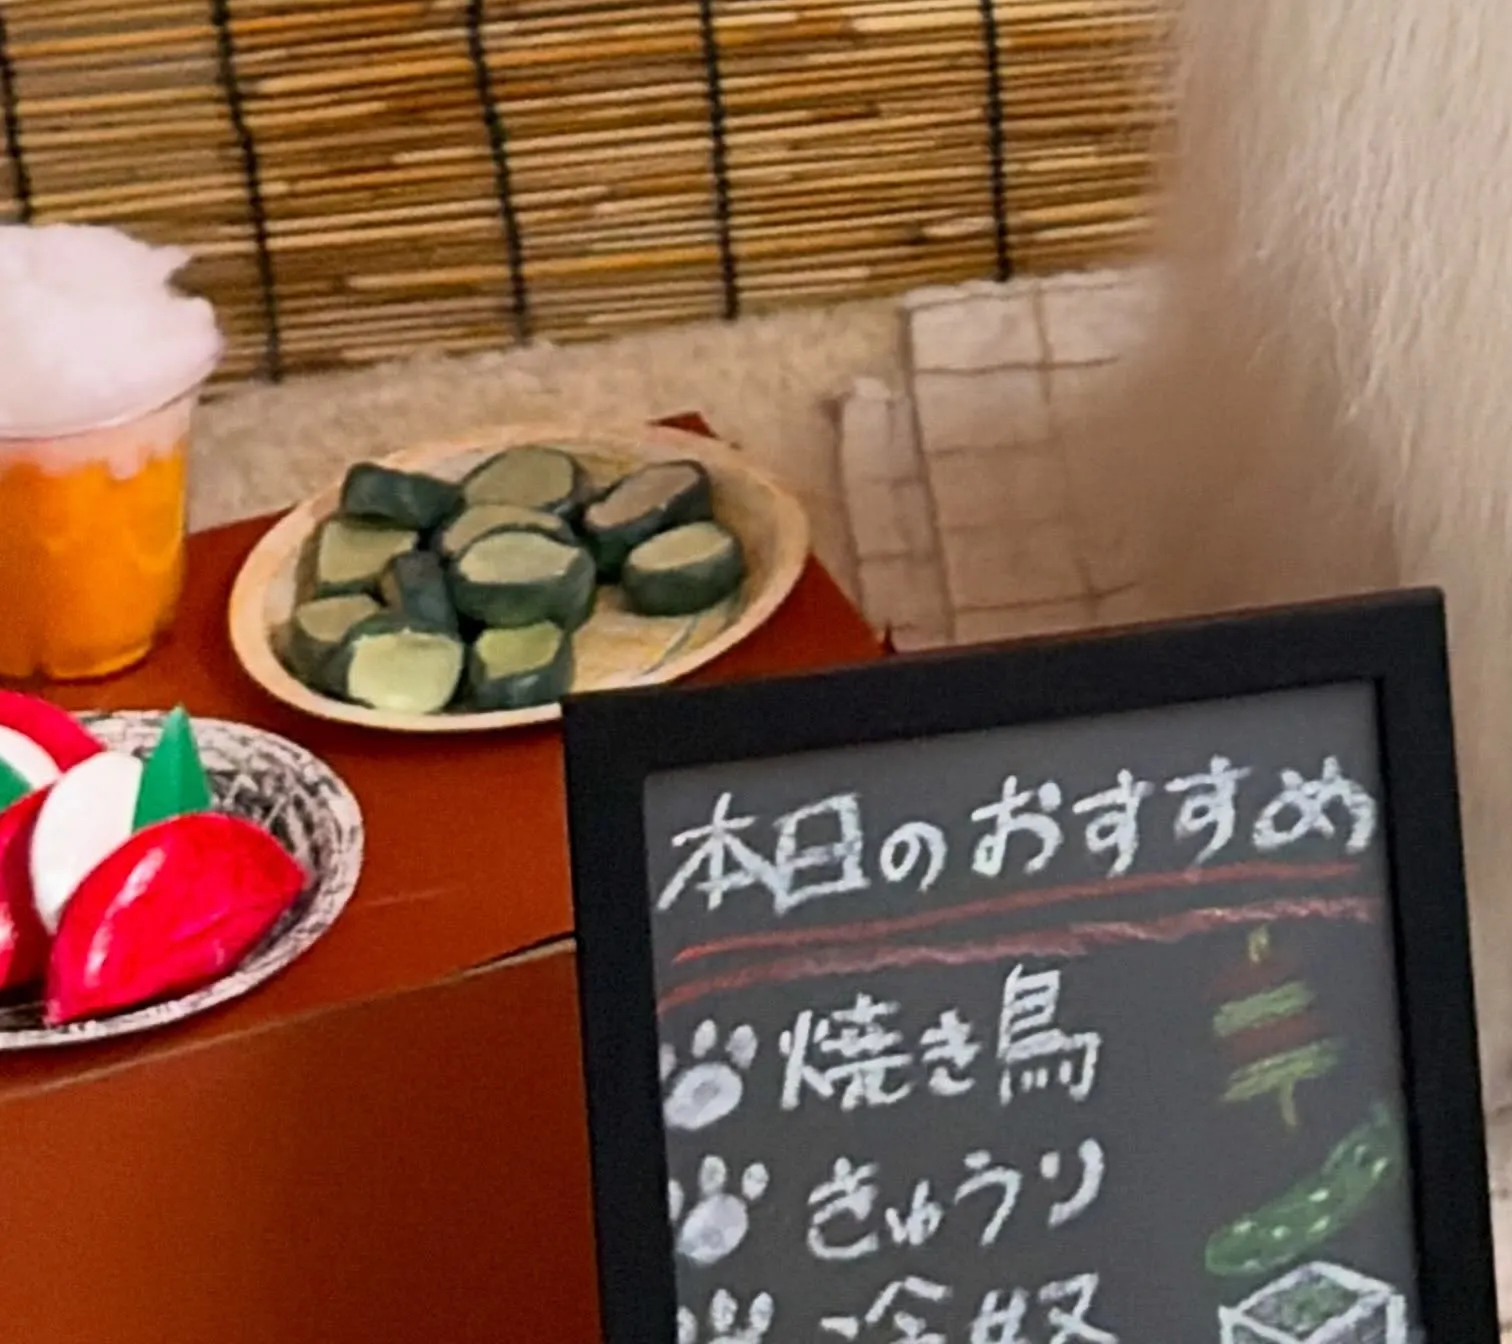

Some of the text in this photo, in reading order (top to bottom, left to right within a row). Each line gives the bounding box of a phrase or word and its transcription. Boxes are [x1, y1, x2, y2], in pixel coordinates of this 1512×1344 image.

[657, 755, 1376, 914] 本日のおすすめ
[779, 962, 1101, 1110] 焼き鳥
[806, 1139, 1105, 1260] きゅうり
